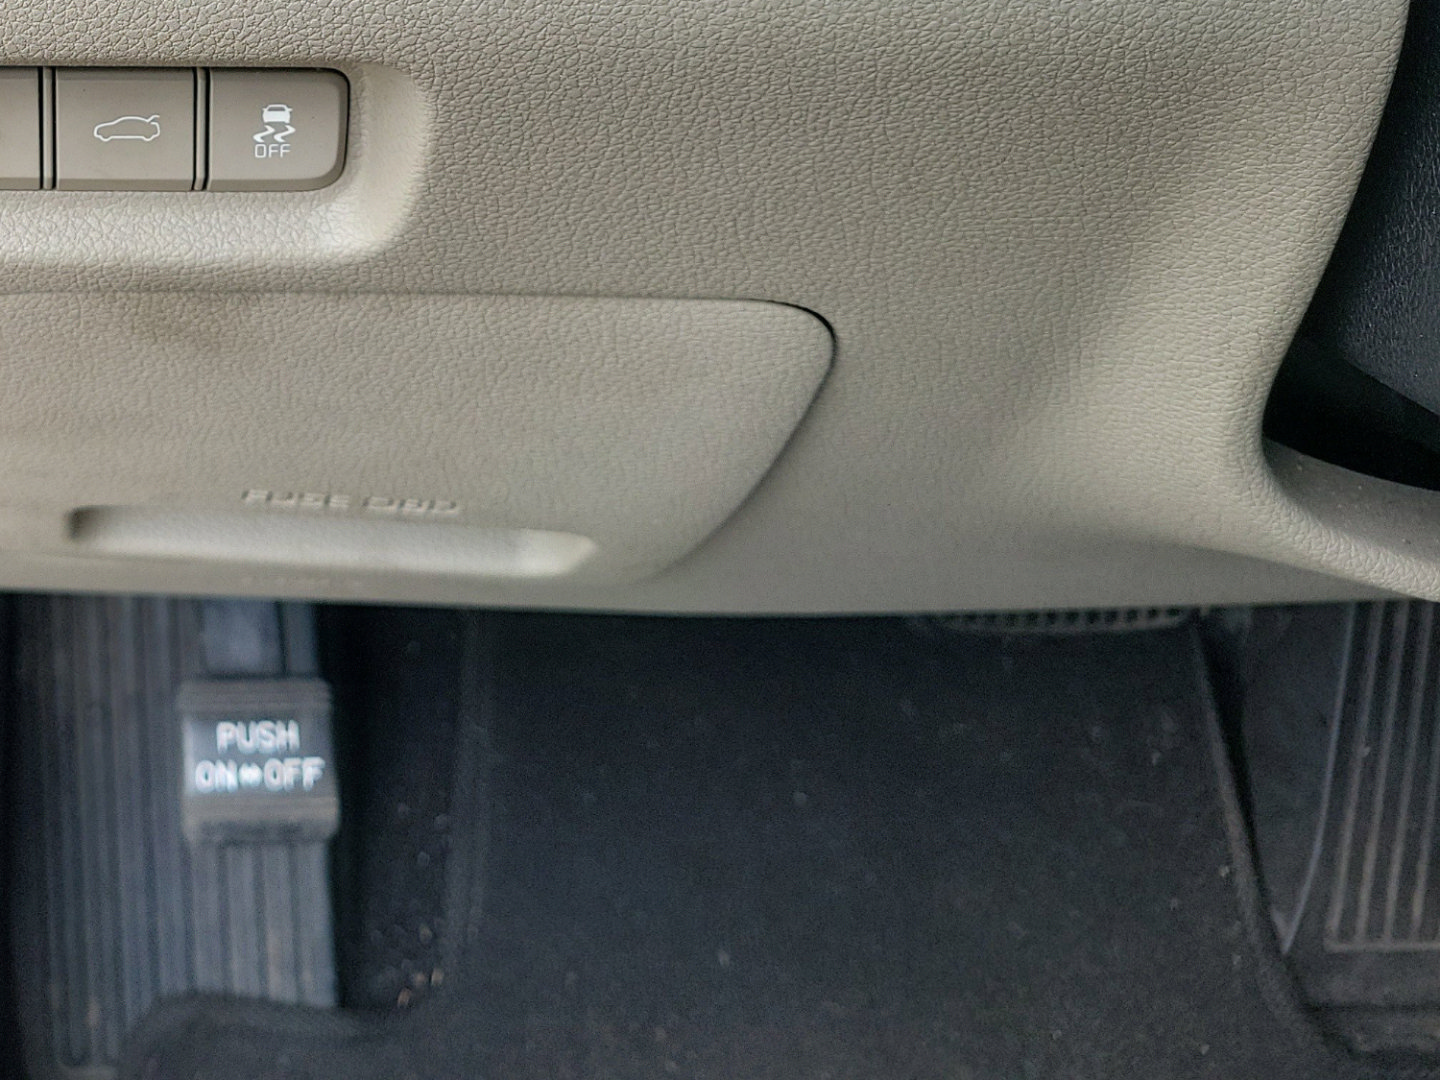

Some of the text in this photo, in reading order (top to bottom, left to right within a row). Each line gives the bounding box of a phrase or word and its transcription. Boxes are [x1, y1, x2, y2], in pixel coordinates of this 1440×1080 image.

[254, 143, 291, 158] OFF
[216, 720, 300, 754] PUSH
[195, 757, 326, 793] ON OFF
